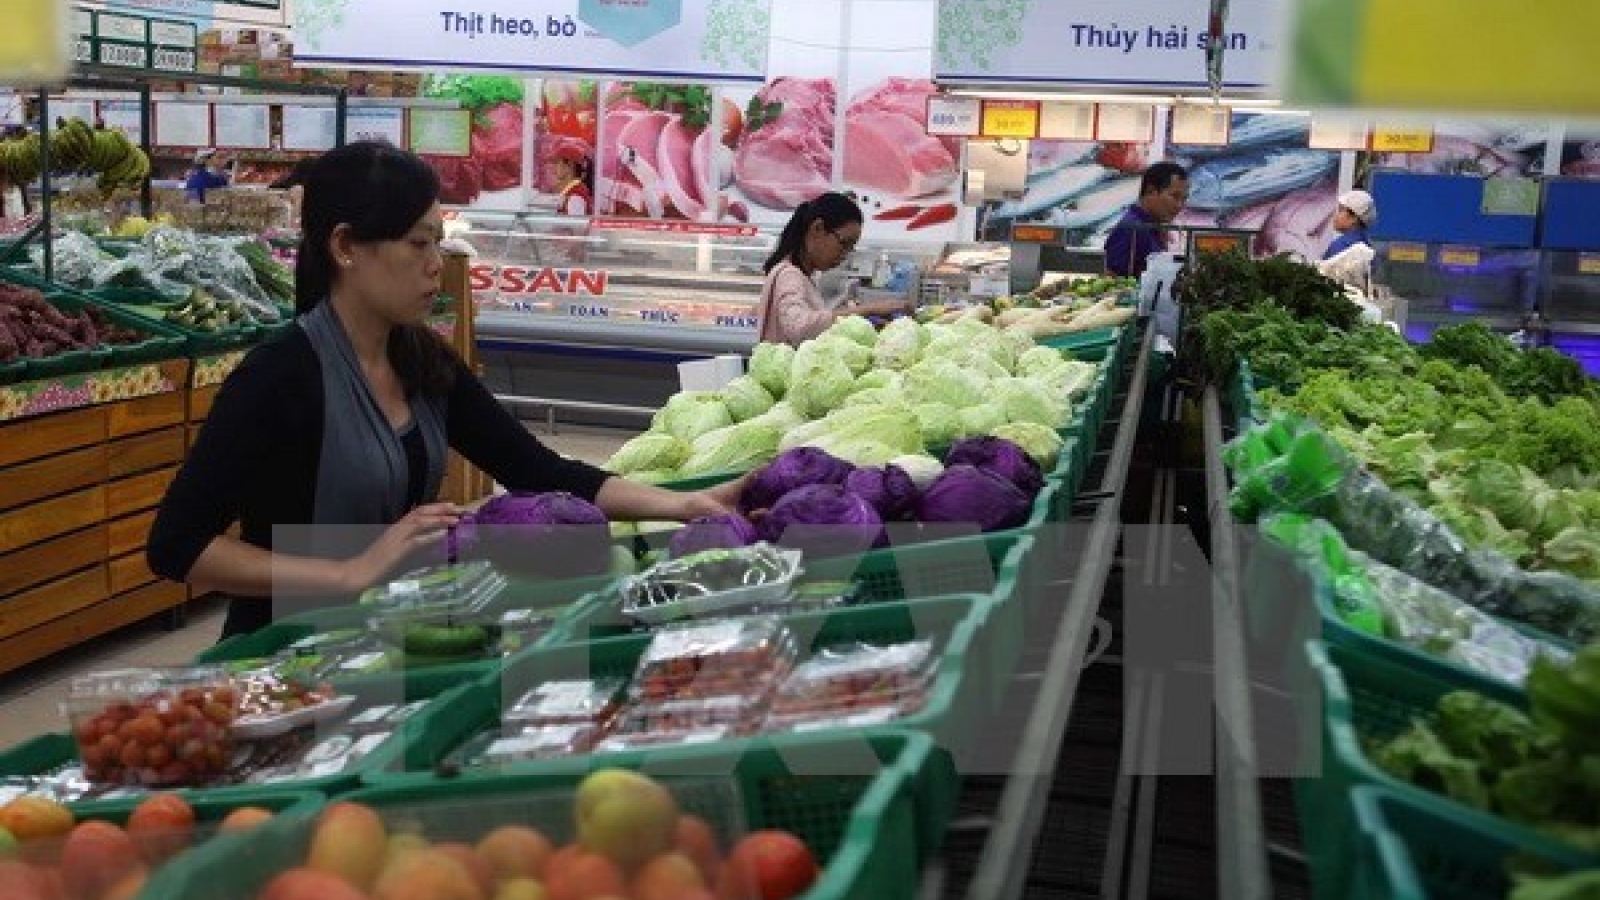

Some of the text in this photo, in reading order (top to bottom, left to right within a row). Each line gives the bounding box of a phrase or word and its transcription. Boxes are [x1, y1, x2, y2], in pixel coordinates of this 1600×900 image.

[440, 11, 484, 39] Thịt
[490, 13, 540, 39] heo,
[1070, 22, 1140, 53] Thủy
[1147, 24, 1188, 50] hải
